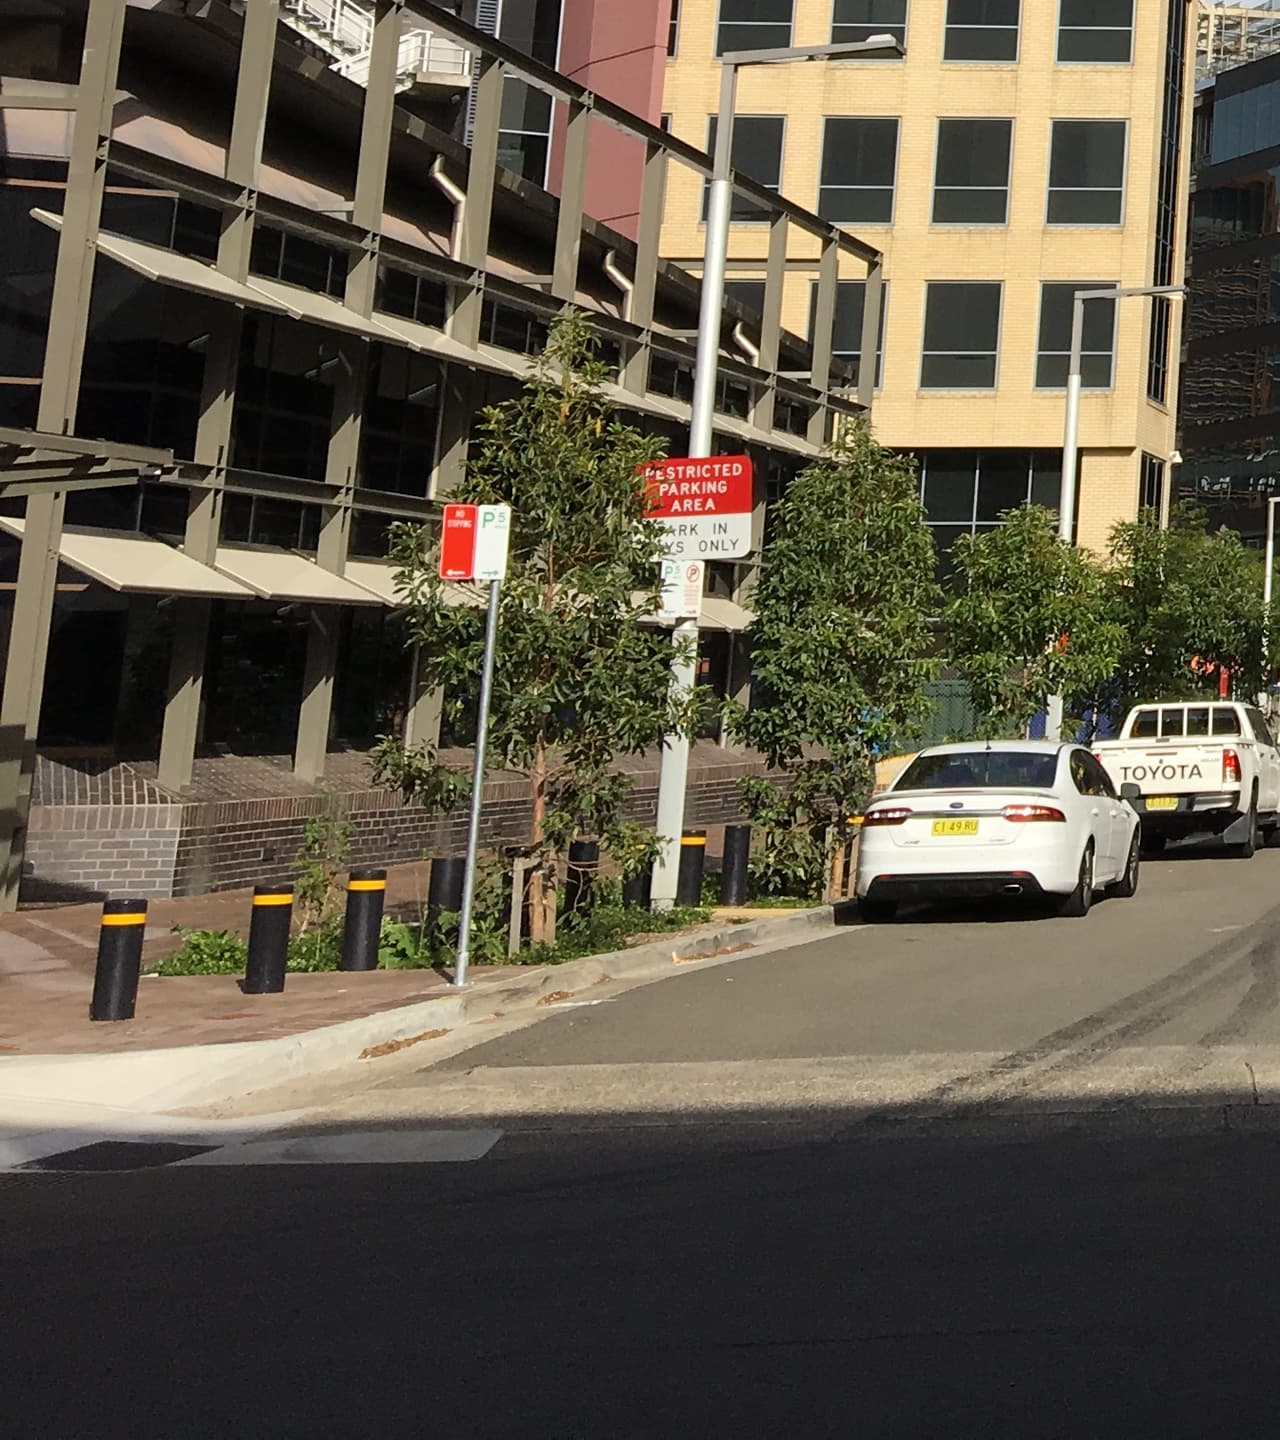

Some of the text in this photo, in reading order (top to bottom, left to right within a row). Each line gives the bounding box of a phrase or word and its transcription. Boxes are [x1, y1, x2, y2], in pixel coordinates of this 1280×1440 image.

[659, 480, 728, 496] PARKING
[670, 498, 716, 512] AREA
[482, 511, 495, 529] P
[666, 522, 727, 536] ARK IN
[698, 538, 739, 552] ONLY
[1119, 764, 1203, 781] TOYOTA
